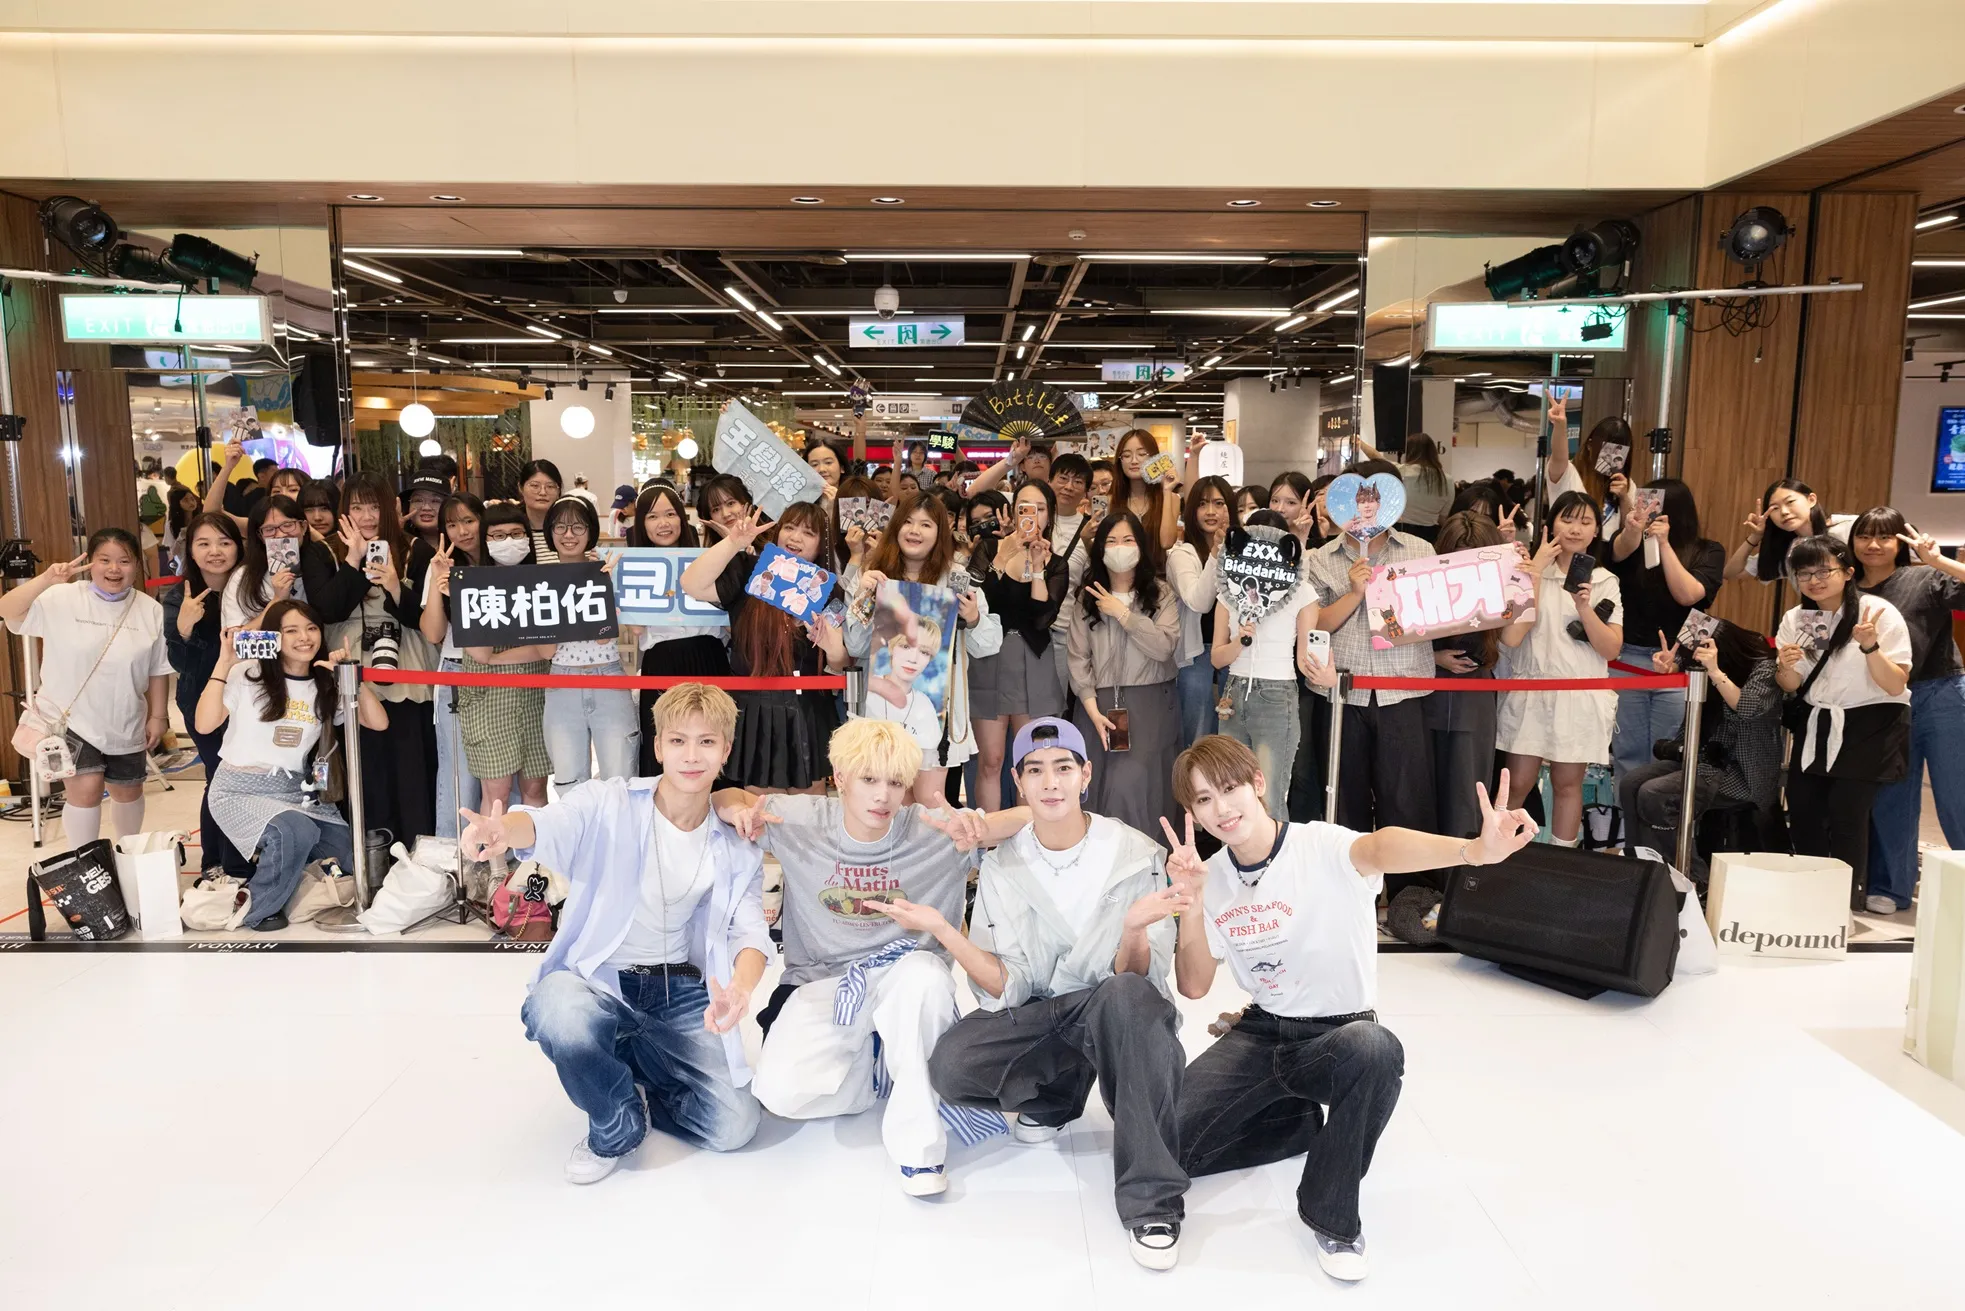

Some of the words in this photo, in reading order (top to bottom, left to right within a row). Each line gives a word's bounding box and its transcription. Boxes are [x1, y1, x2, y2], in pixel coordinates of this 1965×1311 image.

[85, 319, 133, 334] EXIT
[928, 433, 955, 451] 學駿
[1224, 558, 1296, 583] Bidadariku
[460, 579, 608, 630] 陳柏佑
[1394, 560, 1506, 630] 재거
[235, 639, 278, 660] JAGGER
[835, 860, 889, 877] Fruits
[824, 874, 839, 886] du
[843, 875, 900, 892] Matin
[1249, 915, 1259, 923] &
[1250, 901, 1294, 918] SEAFOOD
[1228, 924, 1257, 938] FISH
[1259, 918, 1280, 934] BAR
[1719, 920, 1847, 953] depound
